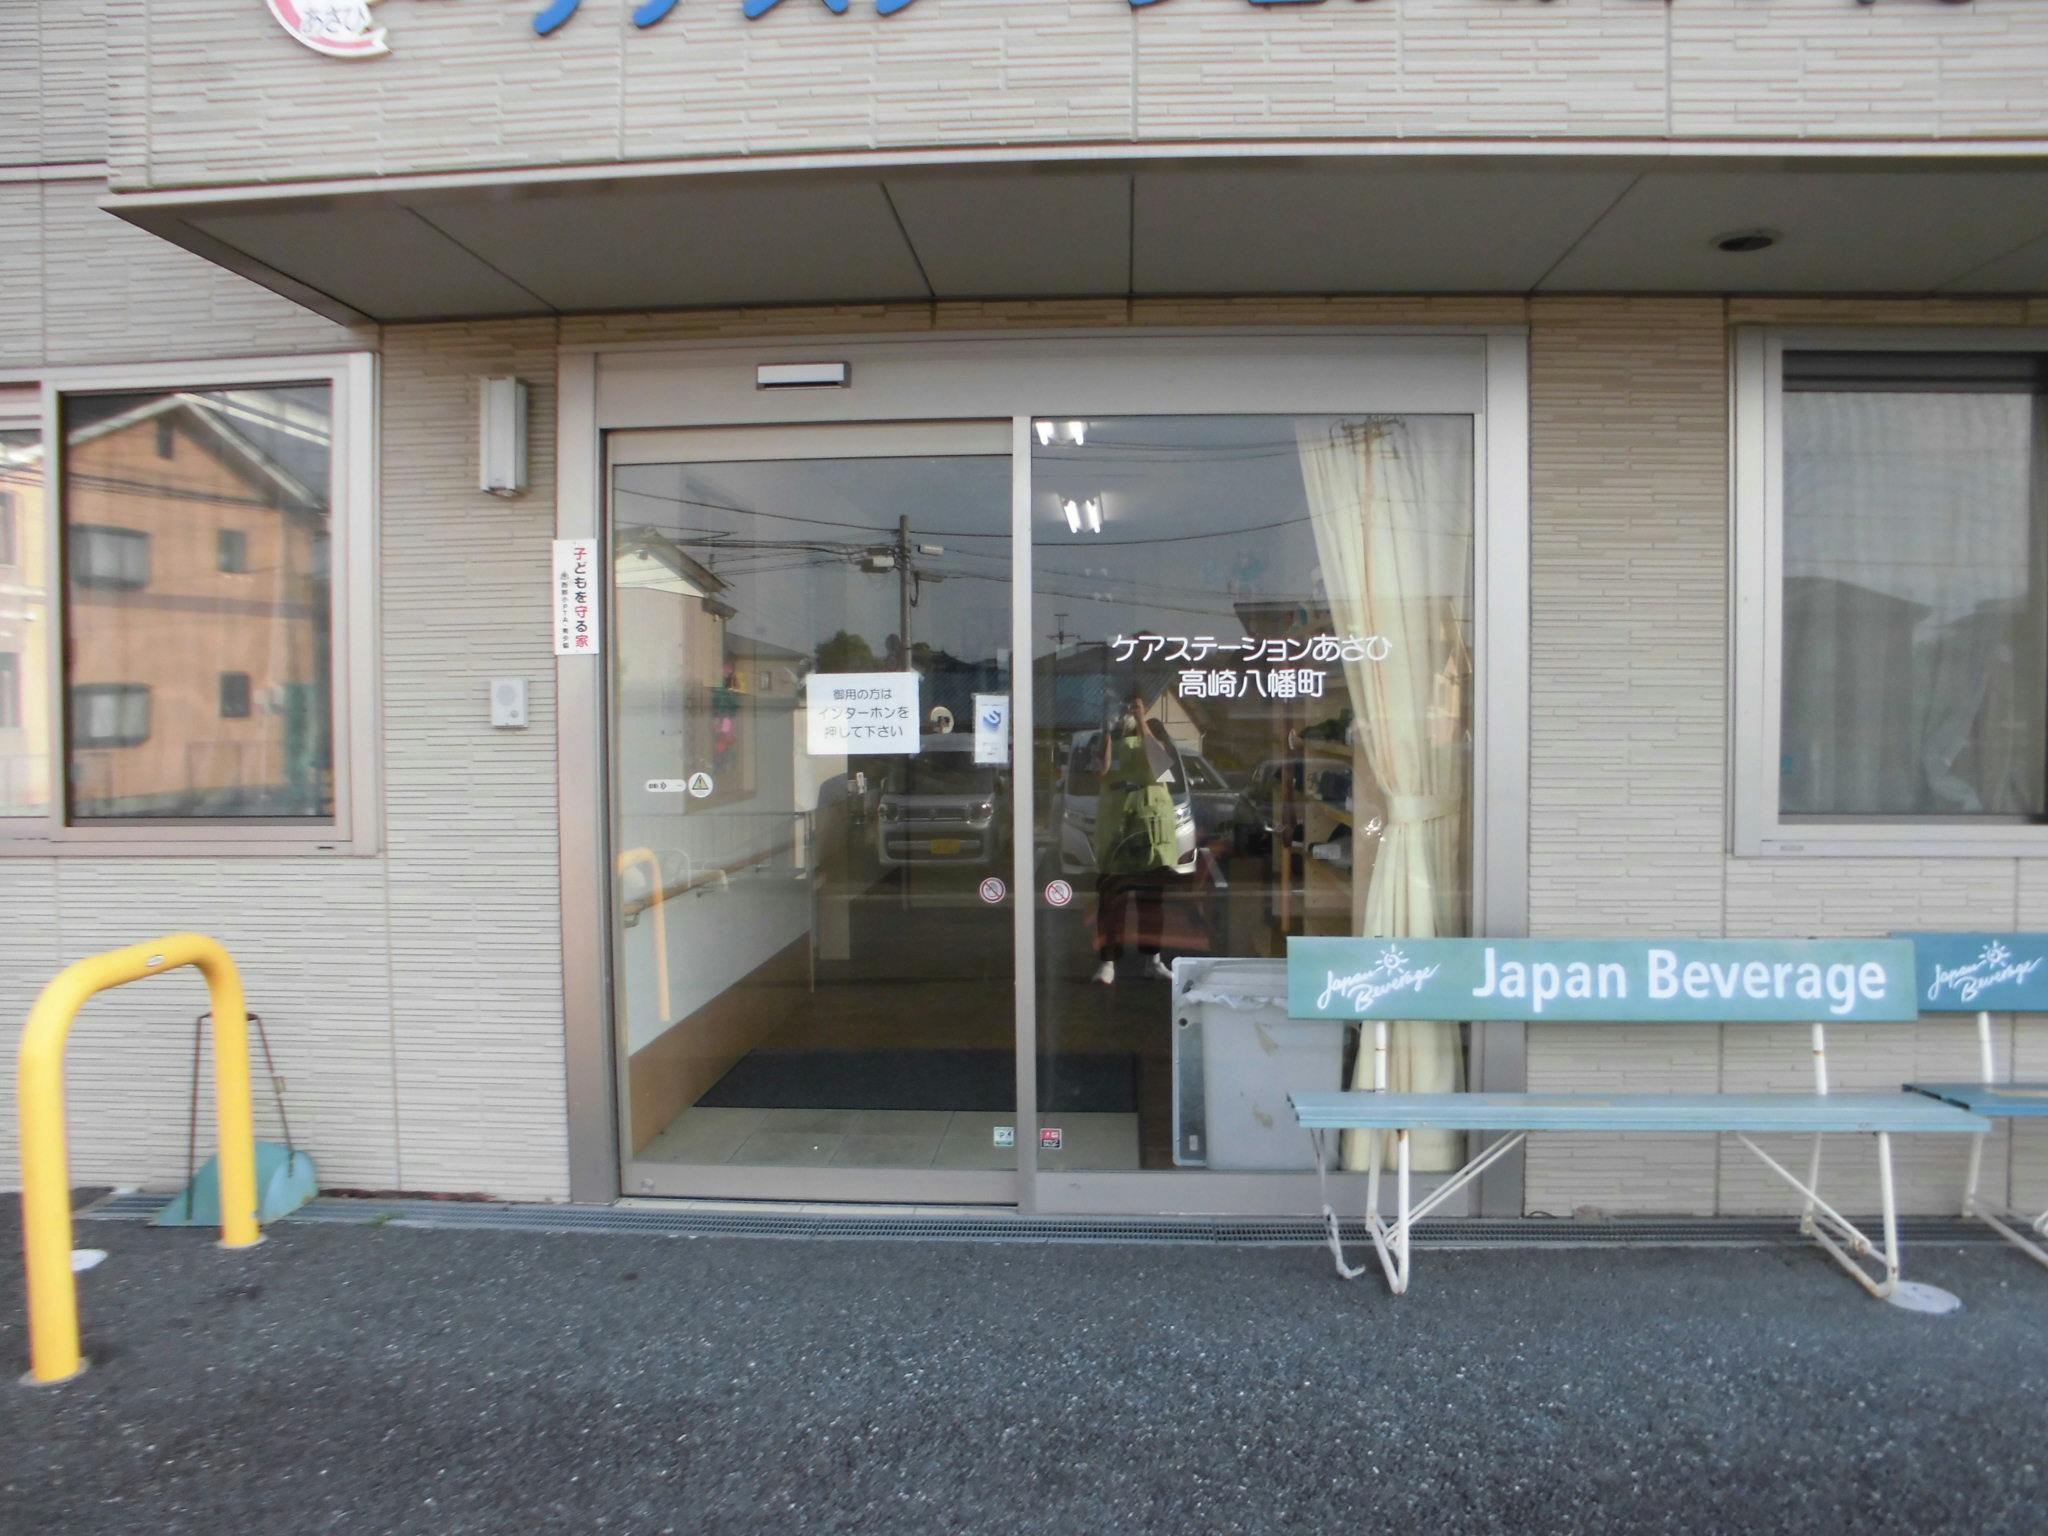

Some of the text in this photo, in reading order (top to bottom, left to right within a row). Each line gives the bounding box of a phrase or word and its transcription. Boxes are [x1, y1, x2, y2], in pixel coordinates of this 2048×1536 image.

[574, 547, 588, 648] 子どもを守る家
[1112, 633, 1393, 663] ケアステーションあさひ
[832, 688, 893, 702] 御用の方は
[1178, 667, 1327, 699] 高崎八幡町
[818, 705, 910, 721] インターホンを
[824, 724, 904, 739] 押して下さい
[1472, 947, 1888, 1015] Japan Beverage
